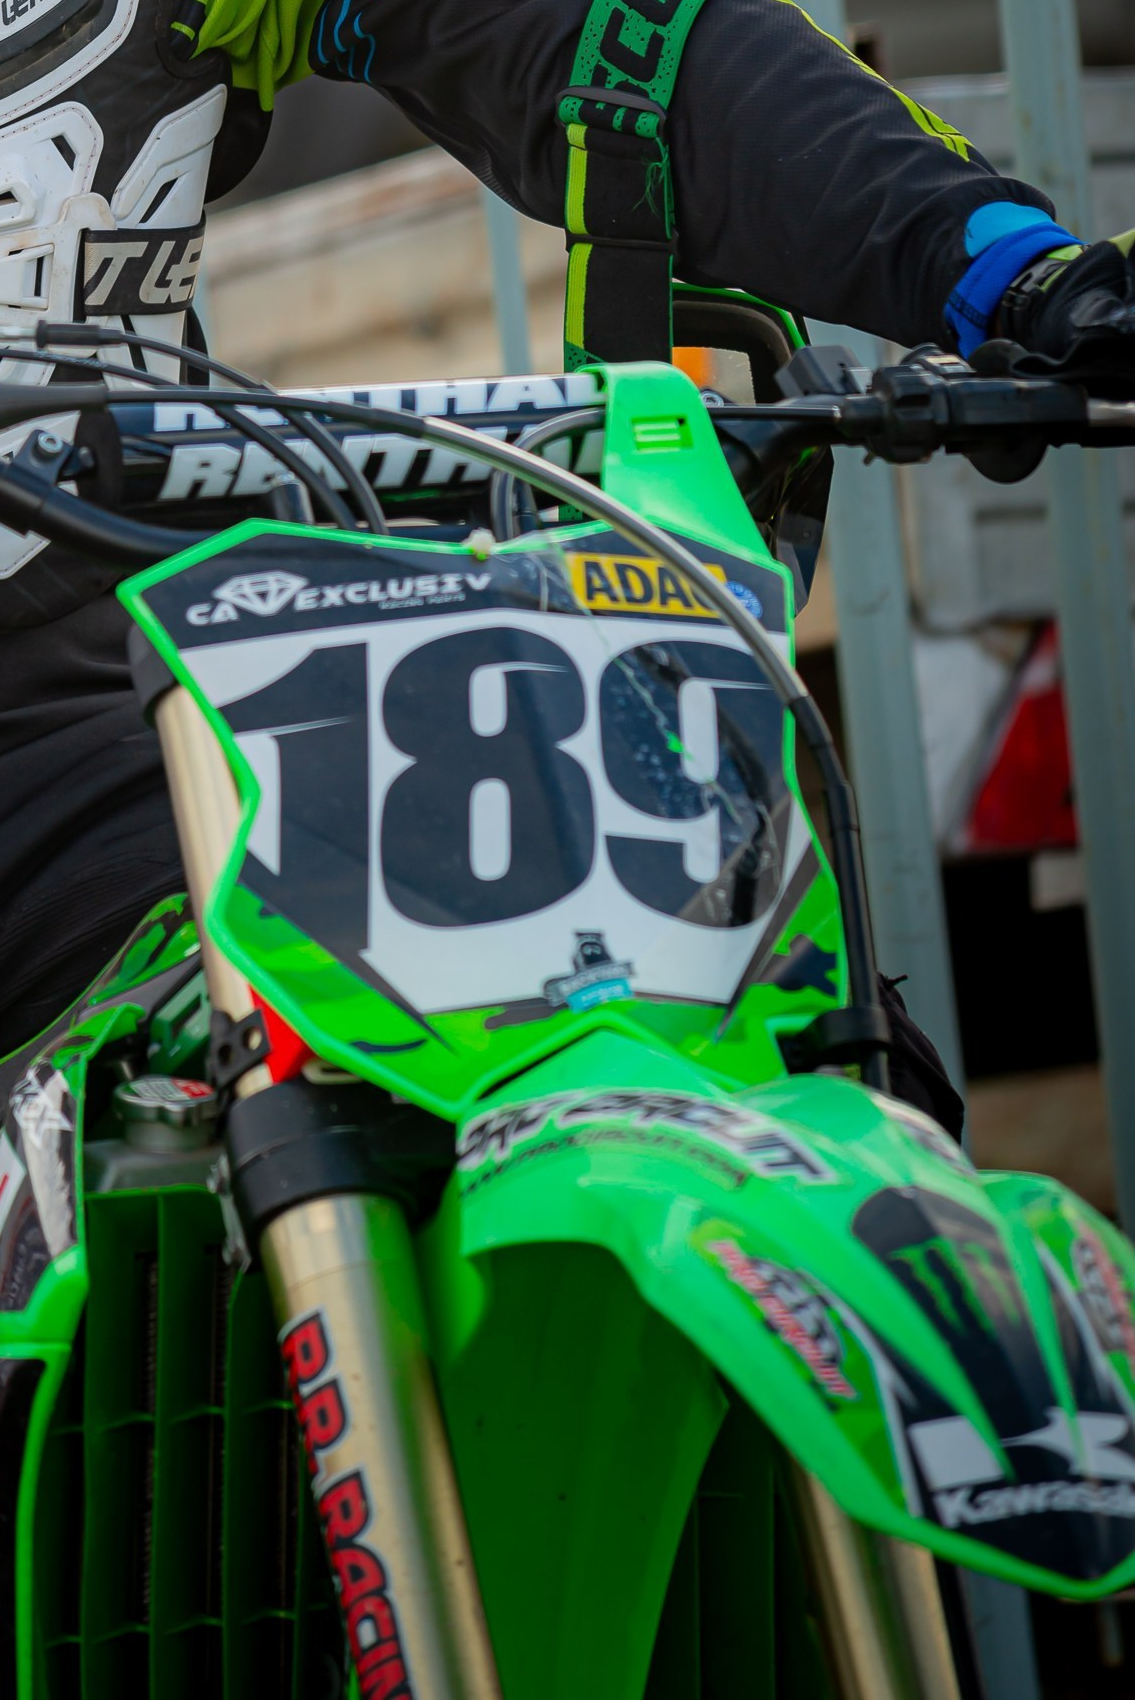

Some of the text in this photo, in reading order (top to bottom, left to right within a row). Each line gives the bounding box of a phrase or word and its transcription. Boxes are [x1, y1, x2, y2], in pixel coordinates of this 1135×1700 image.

[293, 572, 493, 612] EXCLUSIV
[583, 559, 716, 610] ADA
[214, 626, 786, 955] 189
